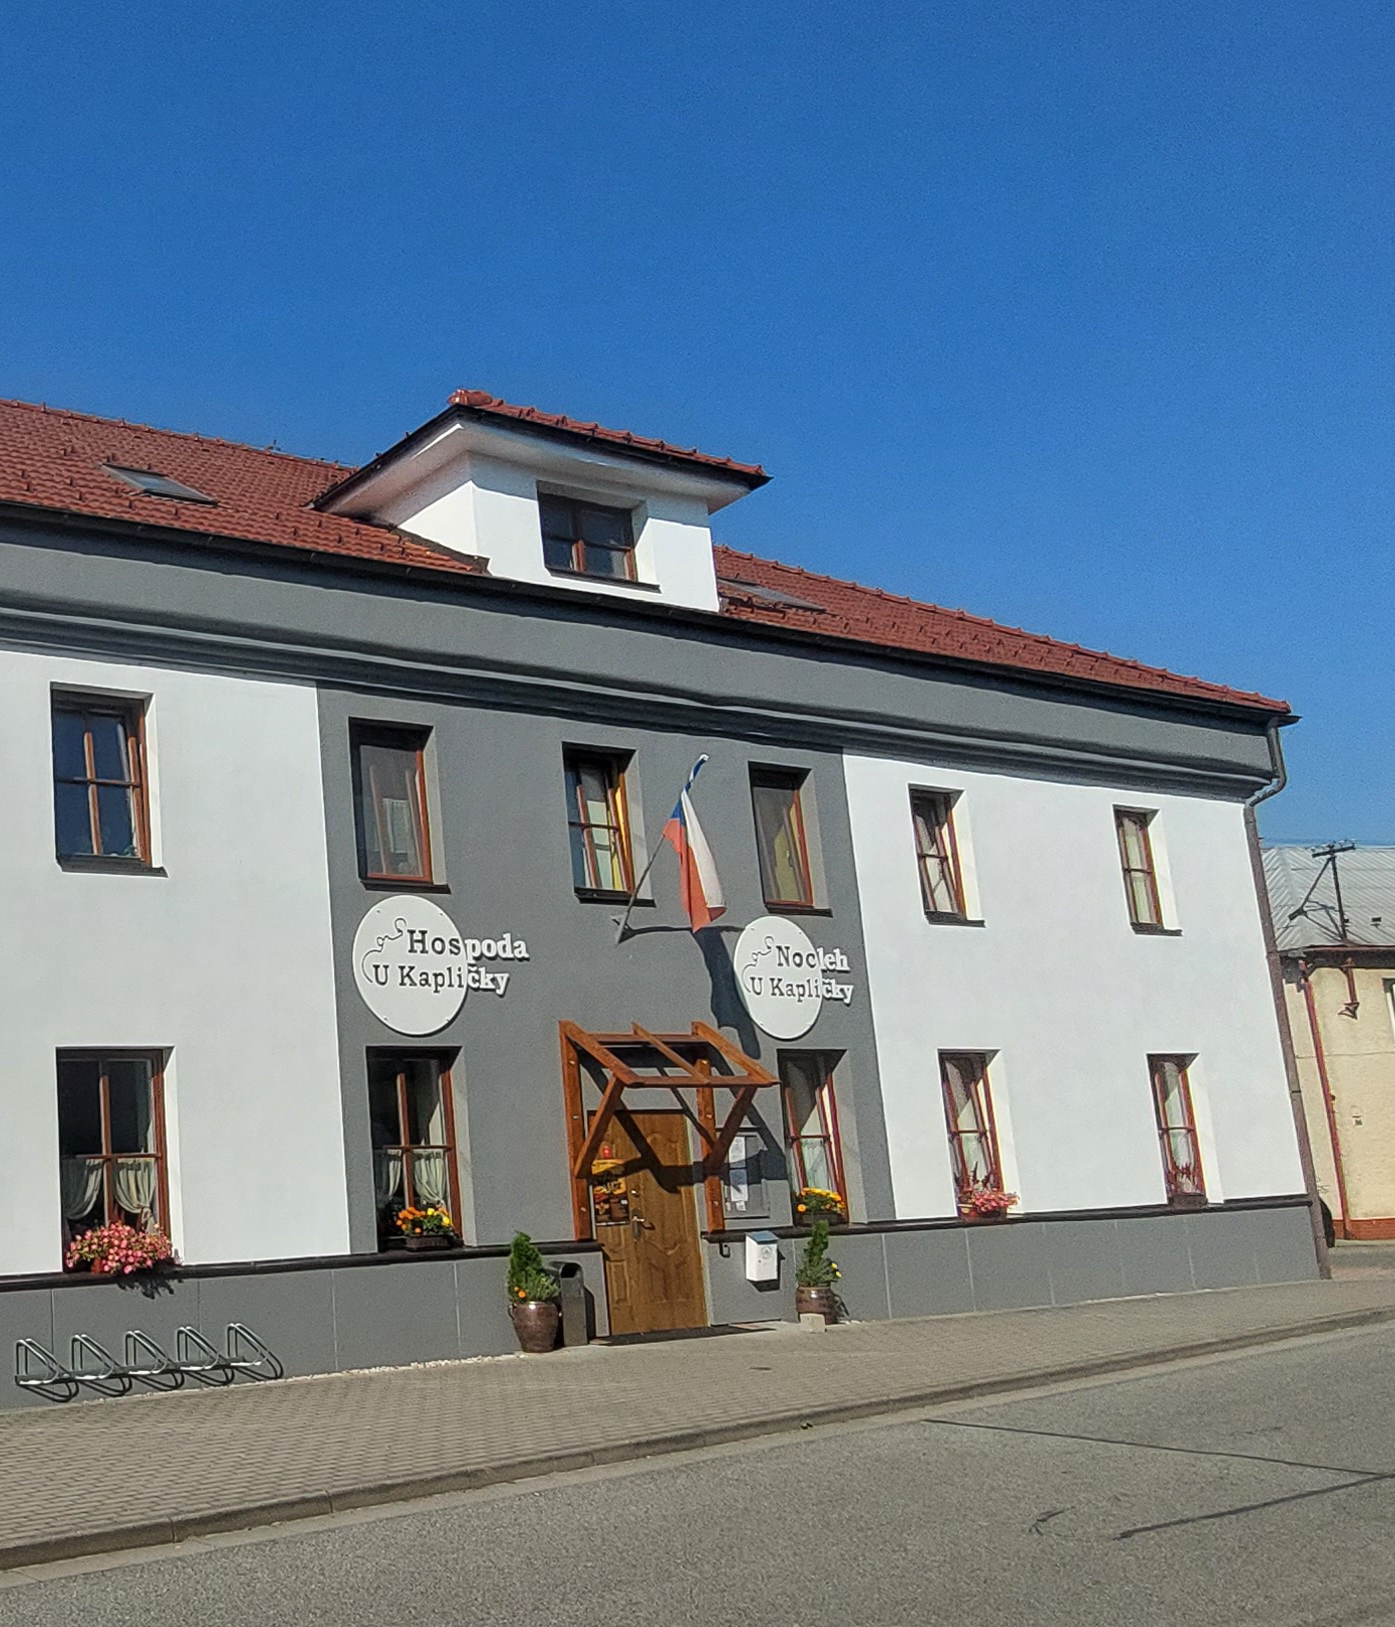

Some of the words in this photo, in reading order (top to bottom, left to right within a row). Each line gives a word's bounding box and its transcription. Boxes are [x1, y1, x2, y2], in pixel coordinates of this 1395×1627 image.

[407, 929, 530, 963] Hospoda
[776, 945, 850, 971] Nocleh
[372, 964, 390, 986] U
[398, 965, 510, 995] Kapličky
[750, 976, 763, 996] U
[769, 977, 854, 1004] Kapličky
